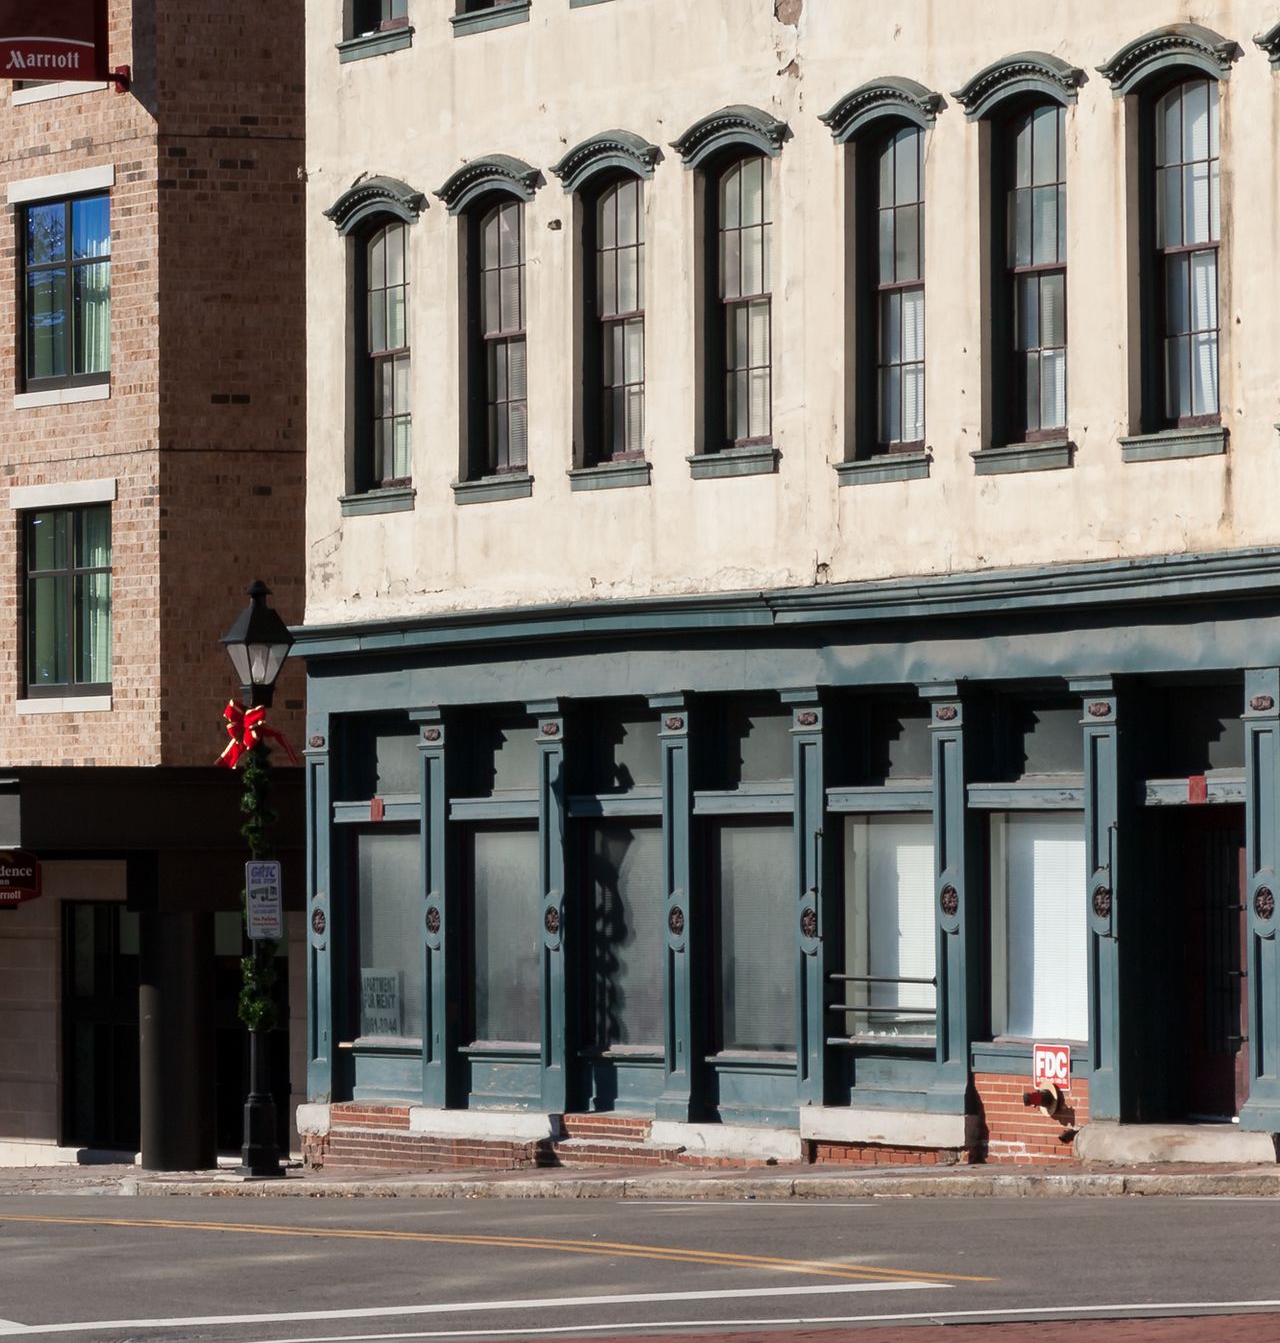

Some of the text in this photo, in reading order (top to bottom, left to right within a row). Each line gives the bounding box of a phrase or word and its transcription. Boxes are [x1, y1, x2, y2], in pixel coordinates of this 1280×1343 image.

[5, 48, 80, 70] Marriott
[377, 993, 396, 1010] RENT
[1035, 1050, 1068, 1078] FDC
